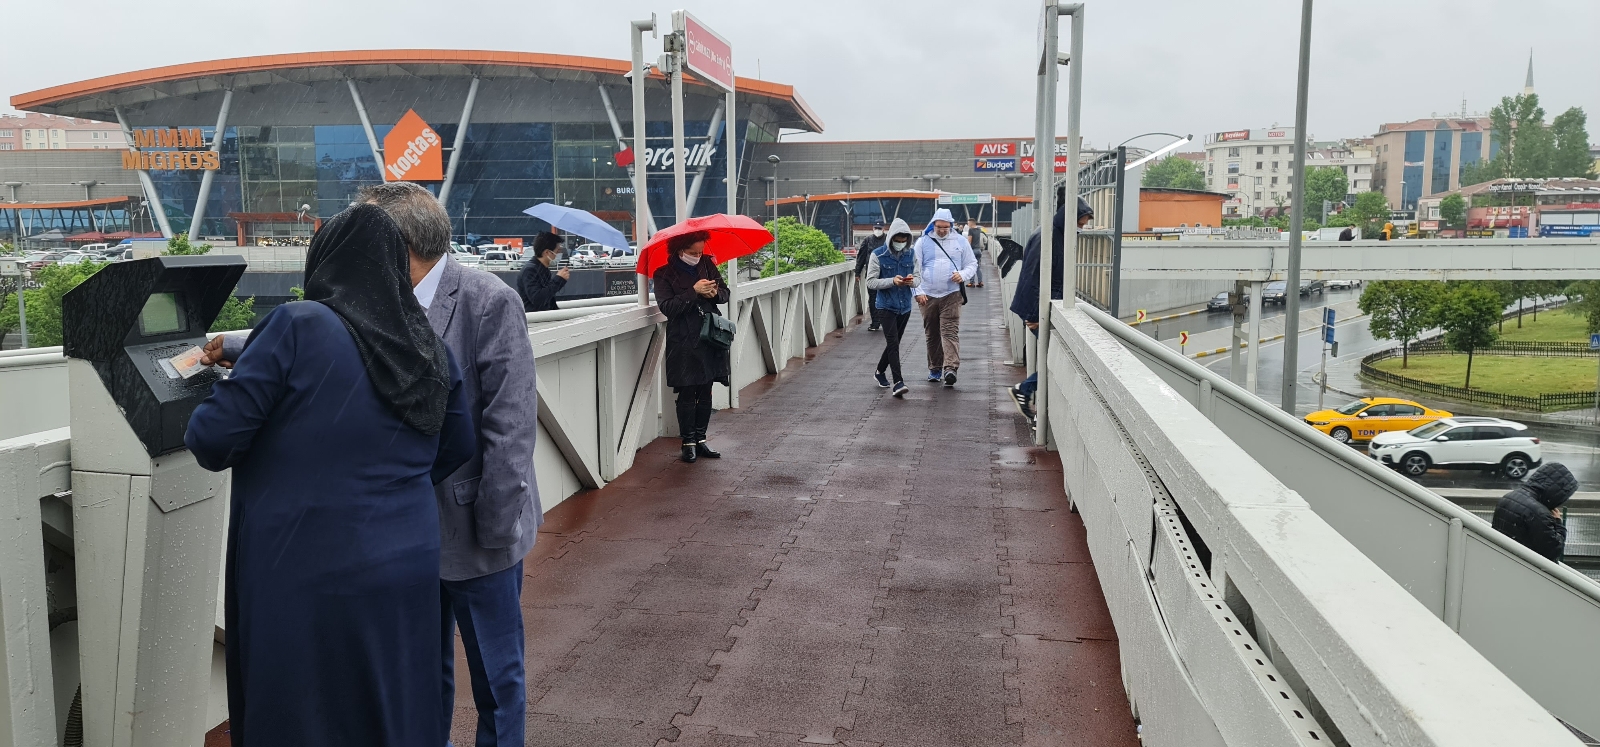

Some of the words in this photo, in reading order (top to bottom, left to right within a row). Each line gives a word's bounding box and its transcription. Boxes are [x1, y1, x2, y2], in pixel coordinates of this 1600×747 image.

[134, 128, 203, 148] MMM
[386, 128, 440, 180] koçtaş
[980, 144, 1009, 154] AVIS
[986, 161, 1013, 170] Budget
